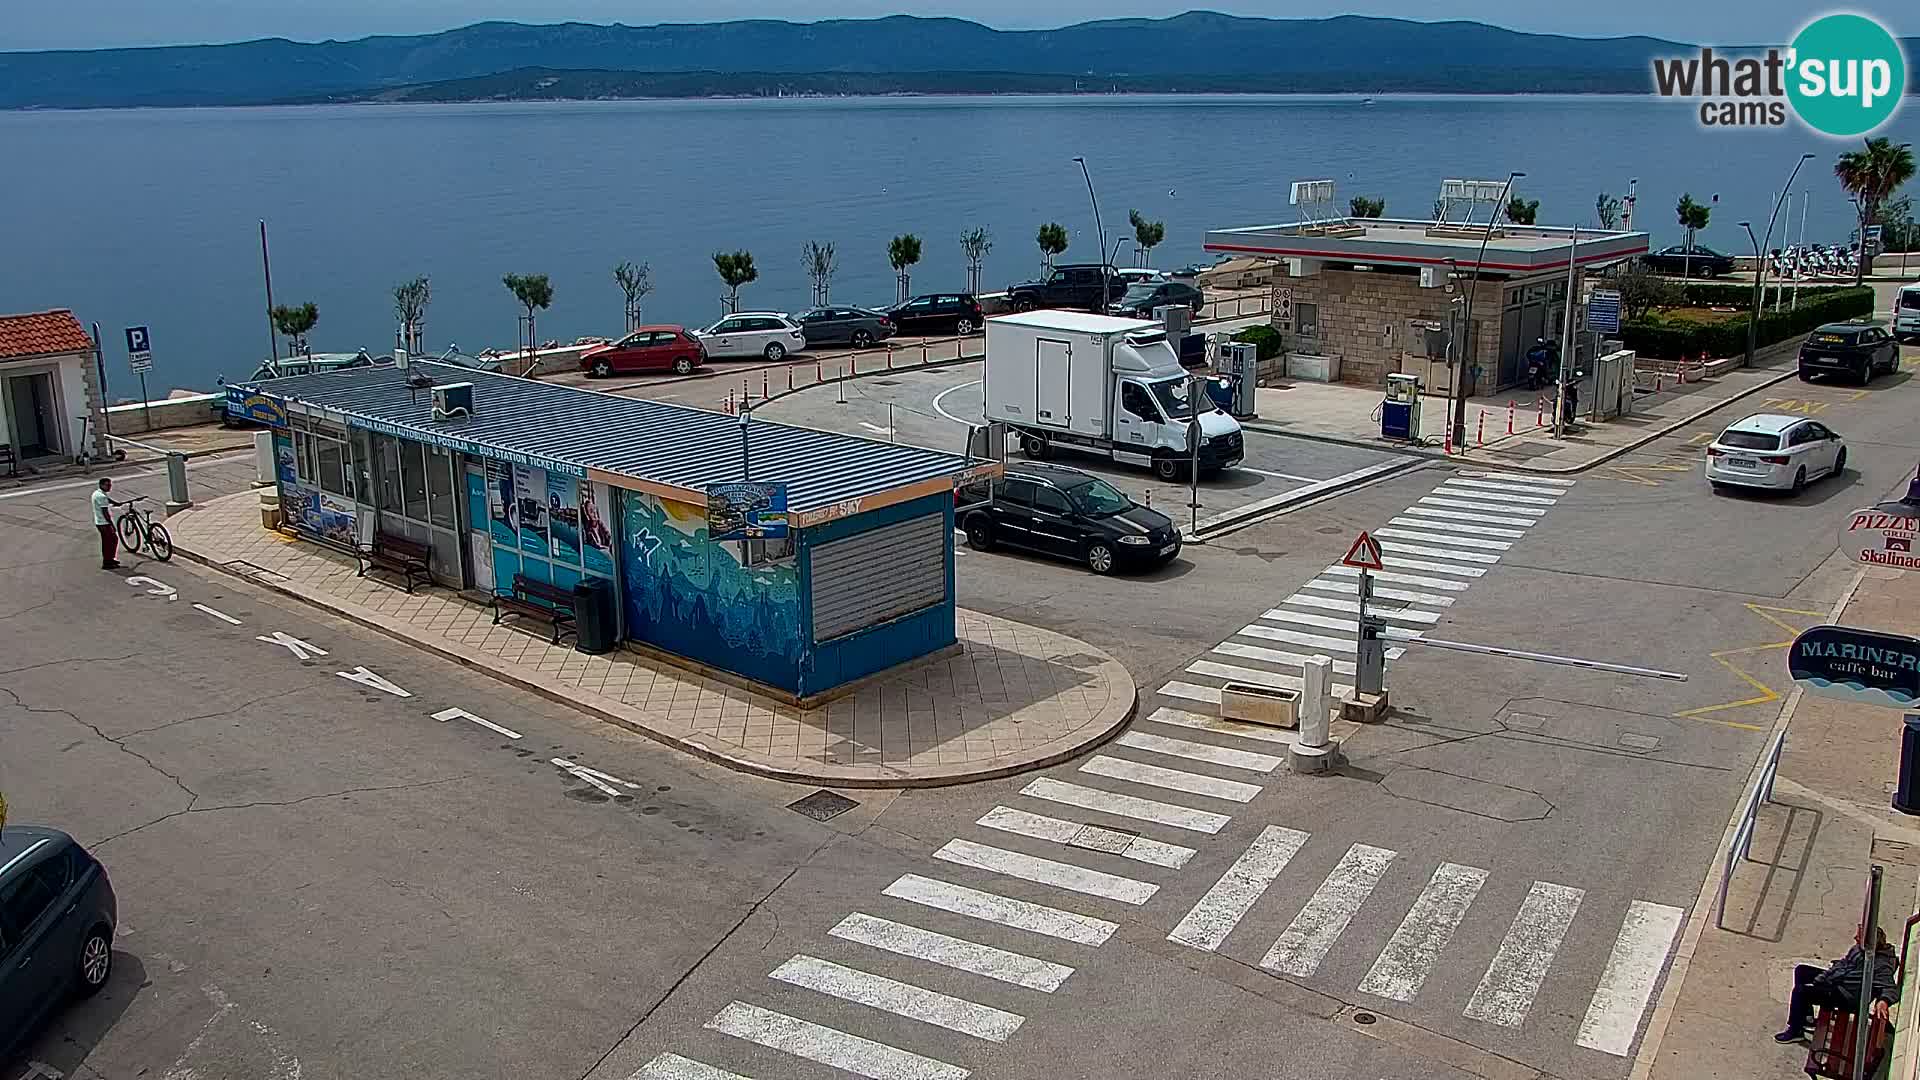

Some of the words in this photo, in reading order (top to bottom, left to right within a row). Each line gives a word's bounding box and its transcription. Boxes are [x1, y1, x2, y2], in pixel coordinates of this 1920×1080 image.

[1760, 398, 1830, 414] TAXI
[397, 428, 437, 444] AUTOBUSNA
[437, 437, 469, 452] POSTAJA
[480, 446, 494, 457] BUS
[494, 449, 527, 464] STATION
[529, 457, 555, 470] TICKET
[556, 463, 583, 476] OFFICE
[1848, 515, 1920, 532] PIZZE
[1882, 529, 1917, 540] GRILL
[1829, 661, 1866, 675] caffe
[1871, 665, 1897, 679] bar
